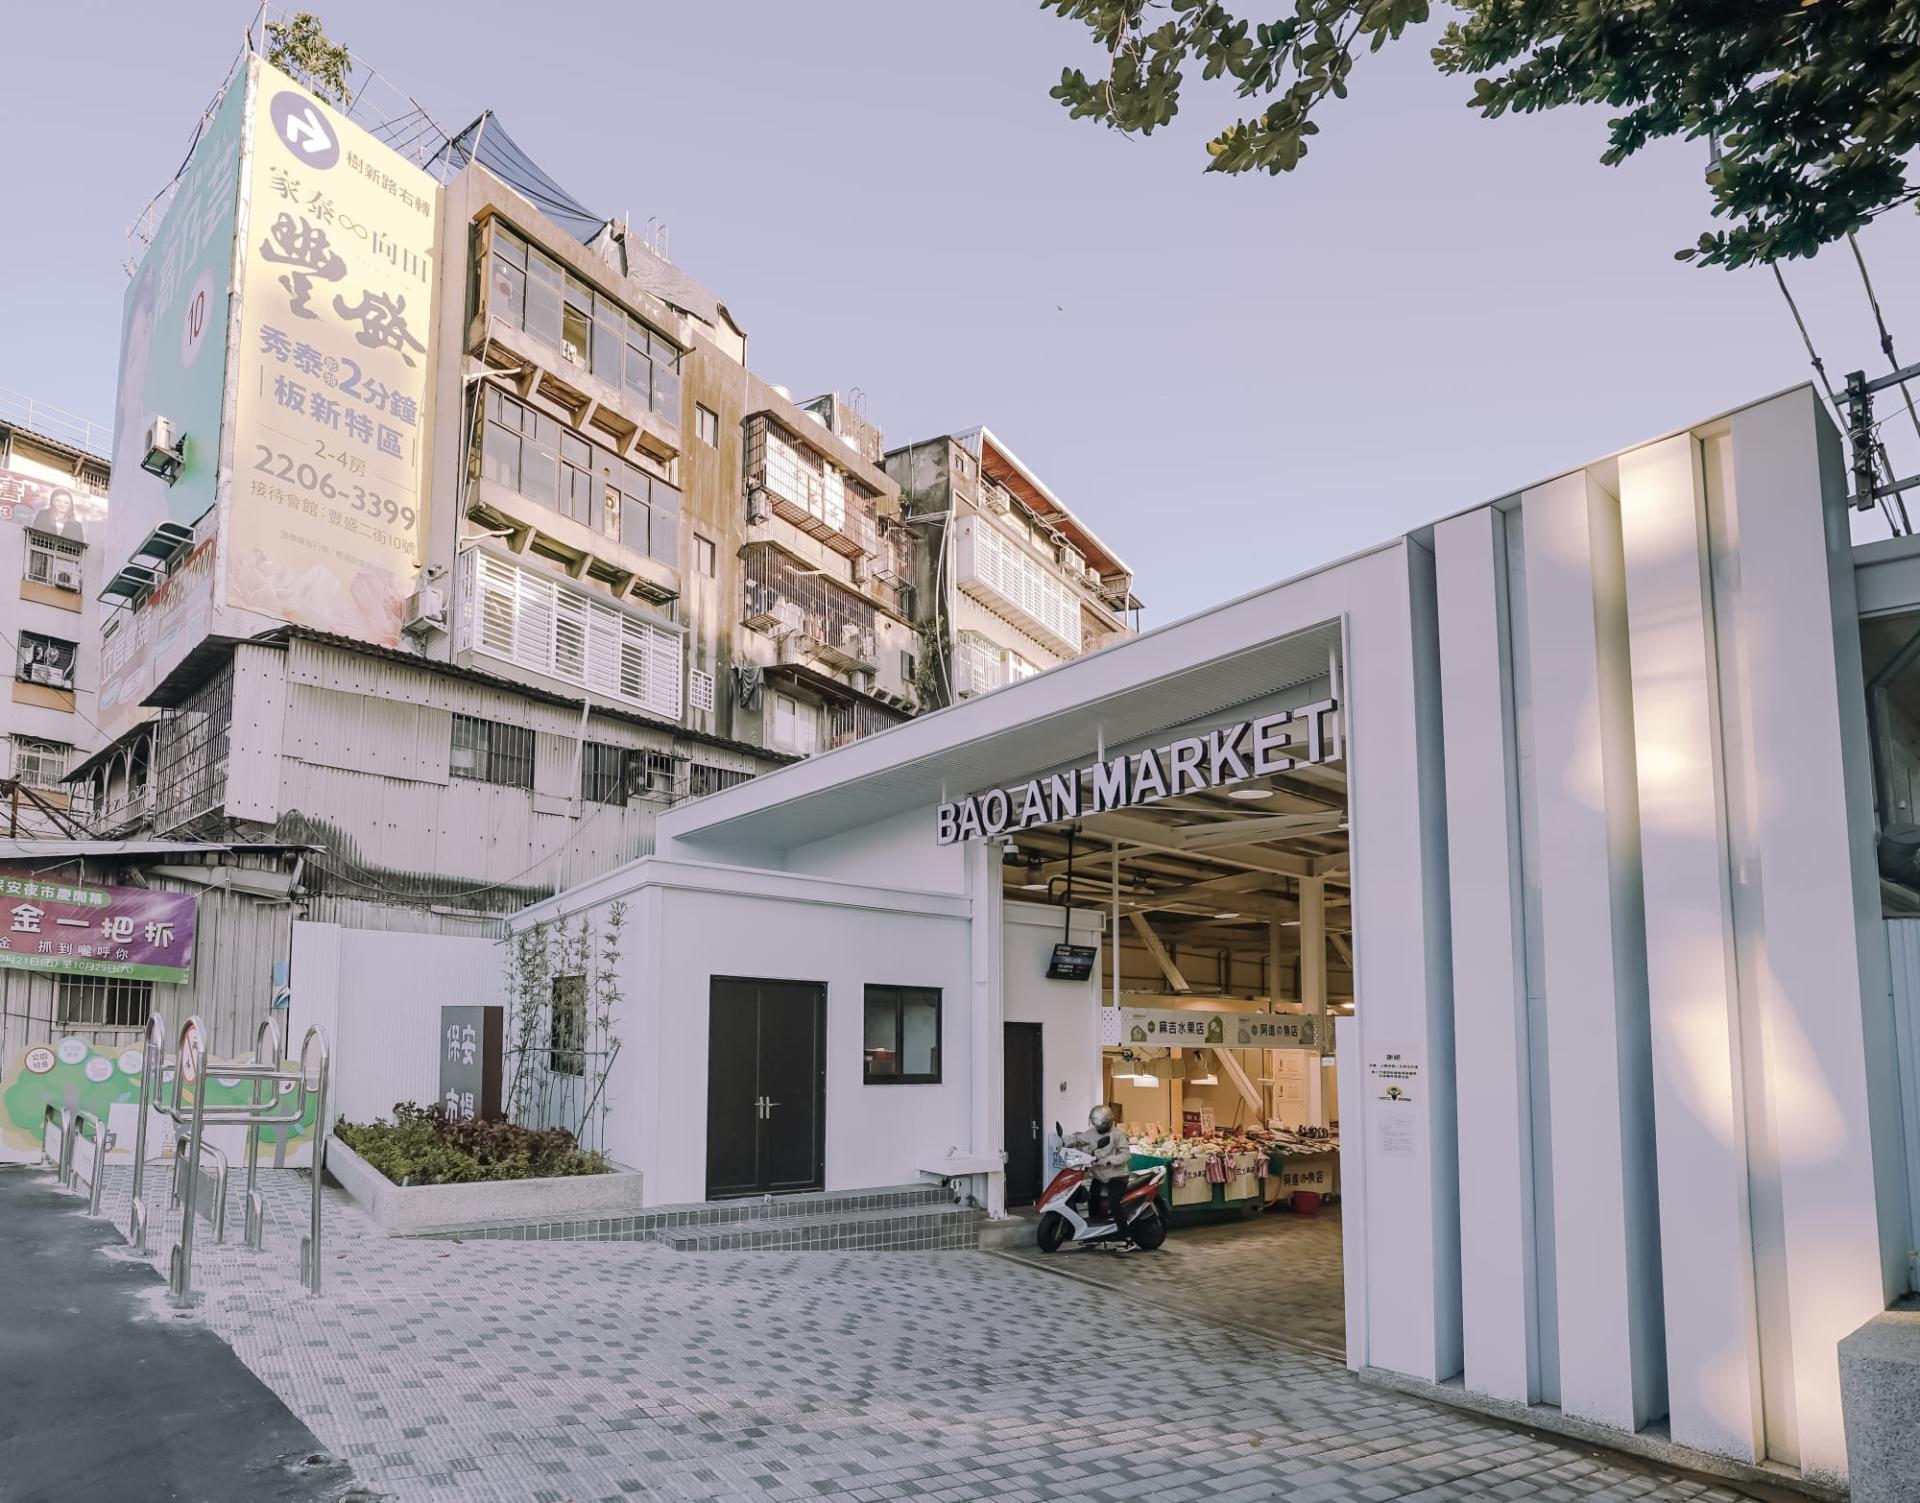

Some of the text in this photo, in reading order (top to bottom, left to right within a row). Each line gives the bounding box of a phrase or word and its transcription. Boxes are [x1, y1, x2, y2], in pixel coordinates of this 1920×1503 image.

[346, 150, 431, 218] 樹新路右轉
[187, 290, 205, 347] 10
[274, 374, 404, 460] 板新特區
[253, 444, 416, 532] 2206-3399
[314, 439, 368, 478] 2-4房
[936, 698, 1338, 846] BAO AN MARKET
